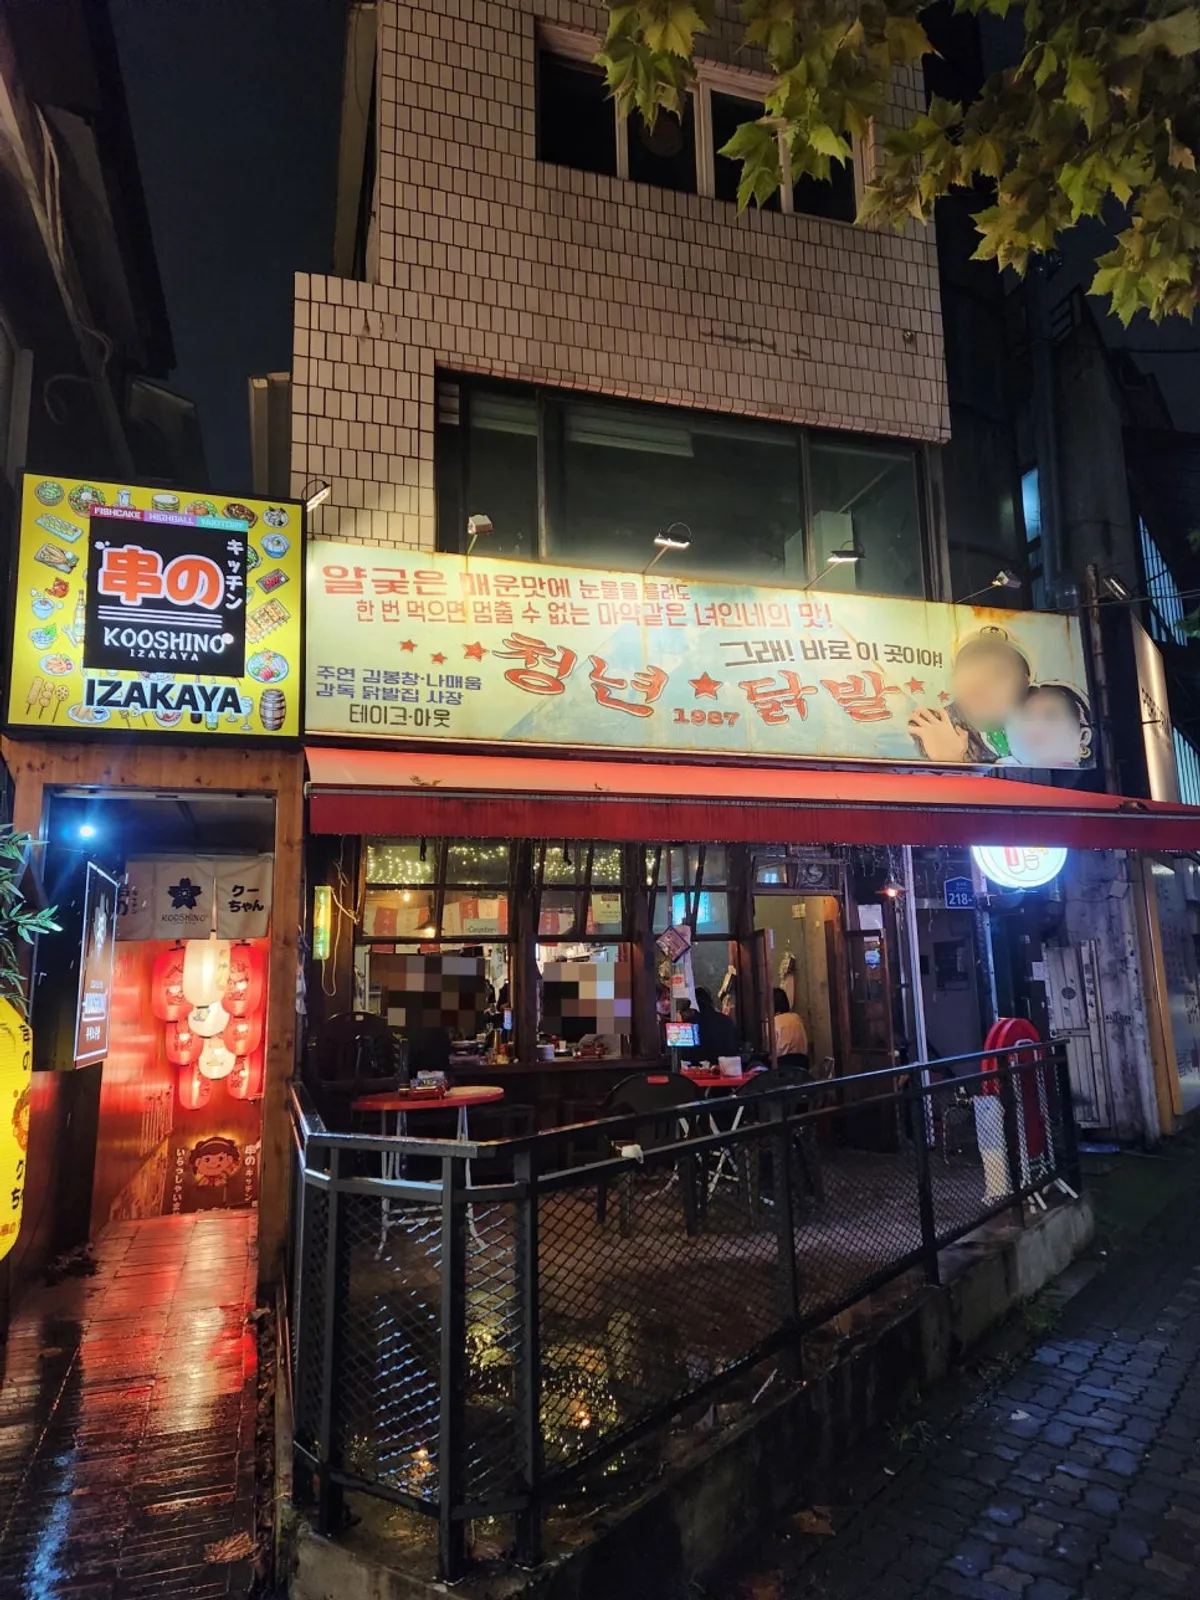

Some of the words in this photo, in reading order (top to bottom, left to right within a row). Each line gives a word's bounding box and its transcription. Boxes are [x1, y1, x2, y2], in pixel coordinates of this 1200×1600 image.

[94, 506, 141, 520] FISHCAKE
[149, 512, 194, 525] HIGHBALL
[98, 544, 225, 610] 串の
[225, 538, 244, 610] キッチン
[322, 564, 447, 596] 얄궂은
[459, 572, 572, 599] 매운맛에
[356, 600, 375, 623] 한
[381, 600, 400, 623] 번
[407, 600, 466, 624] 먹으면
[473, 601, 514, 625] 멈출
[521, 601, 541, 624] 수
[549, 602, 591, 626] 없는
[597, 602, 688, 627] 마약같은
[799, 603, 834, 630] 맛!
[103, 626, 226, 654] KOOSHINO
[129, 648, 200, 662] IZAKAYA
[719, 639, 796, 668] 그래!
[800, 639, 852, 662] 바로
[857, 641, 879, 662] 이
[884, 643, 943, 669] 곳이야!
[316, 665, 356, 682] 주연
[491, 632, 669, 718] 청년
[84, 678, 243, 714] IZAKAYA
[316, 682, 355, 699] 감독
[362, 686, 420, 703] 닭발집
[426, 690, 464, 706] 사장
[349, 703, 451, 729] 테이크·아웃
[673, 708, 740, 727] 1987
[232, 884, 259, 898] クー
[228, 900, 264, 913] ちゃん
